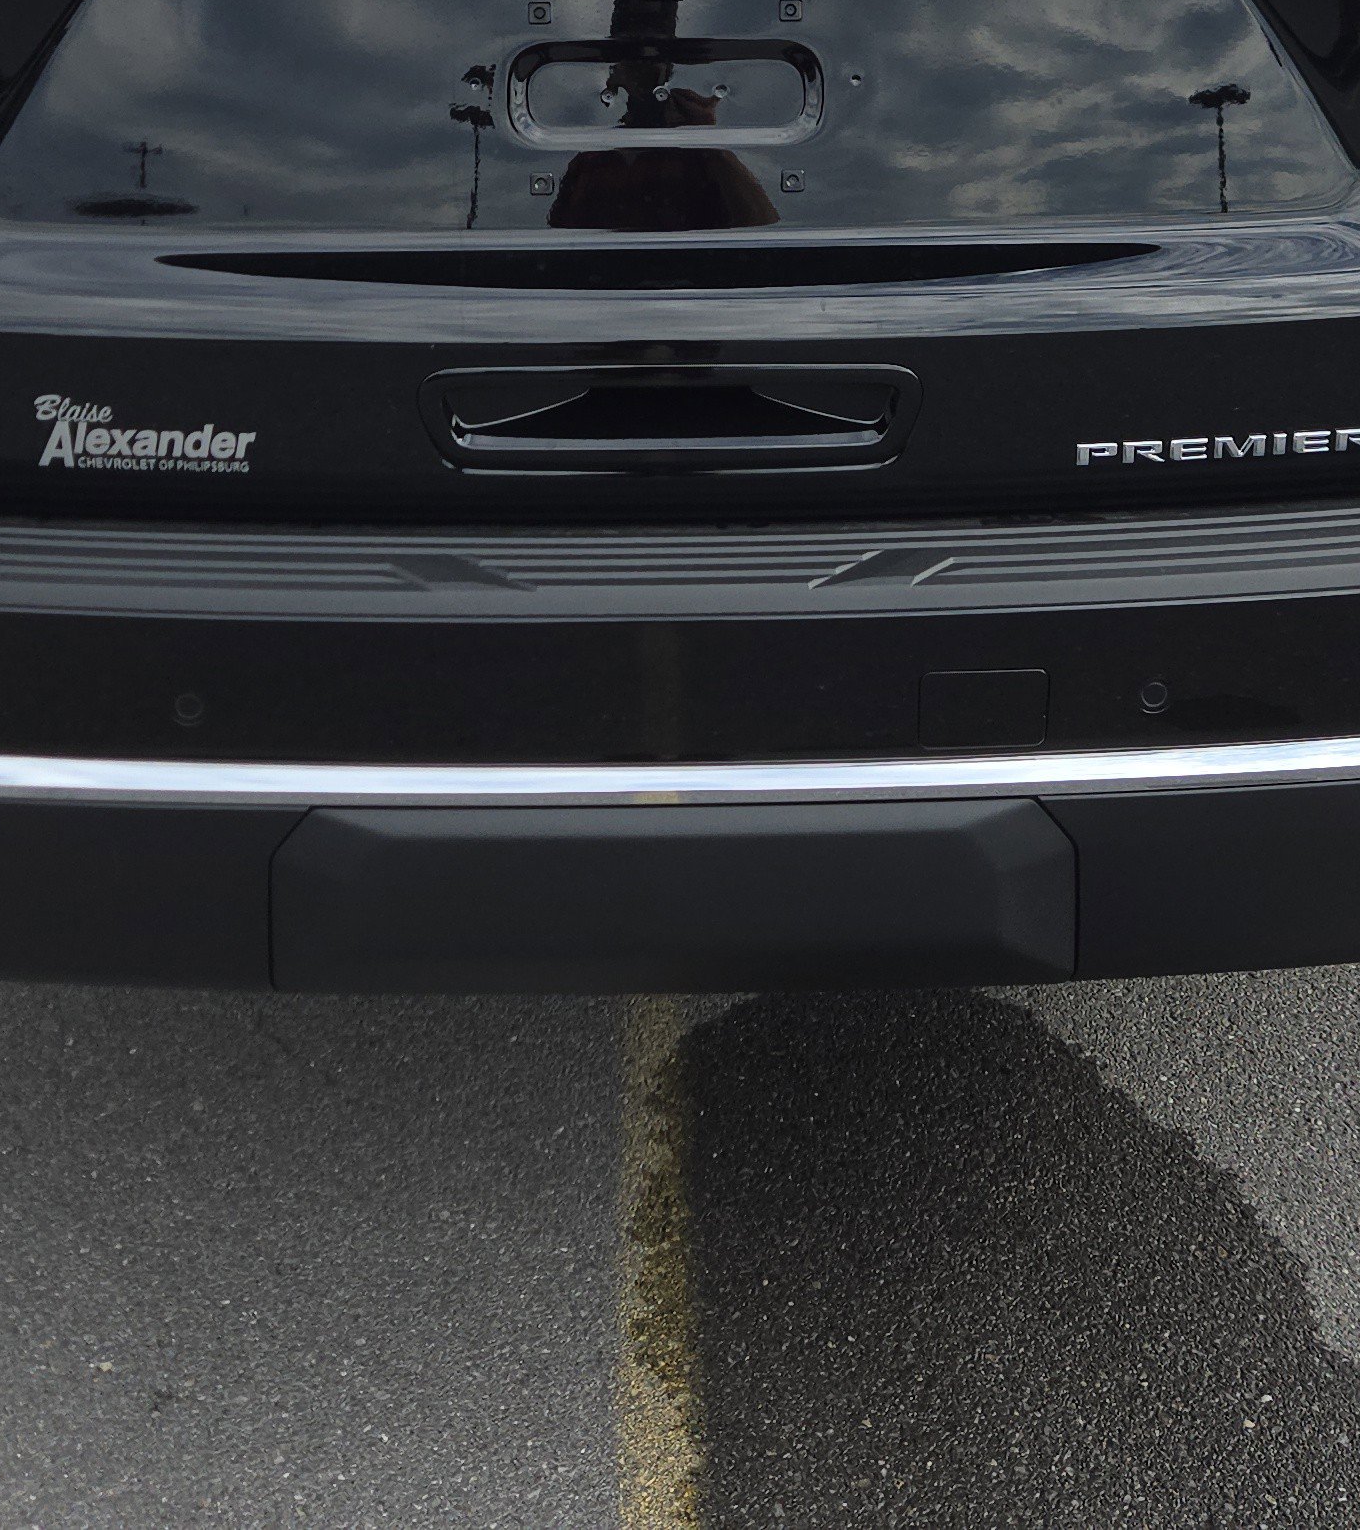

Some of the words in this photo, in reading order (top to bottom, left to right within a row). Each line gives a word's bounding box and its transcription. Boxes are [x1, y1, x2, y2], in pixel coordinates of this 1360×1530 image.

[34, 394, 113, 423] Blaise
[39, 420, 256, 467] Alexander
[77, 456, 156, 470] CHEVROLET
[158, 458, 175, 471] OF
[176, 459, 250, 473] PHILIPSBURG
